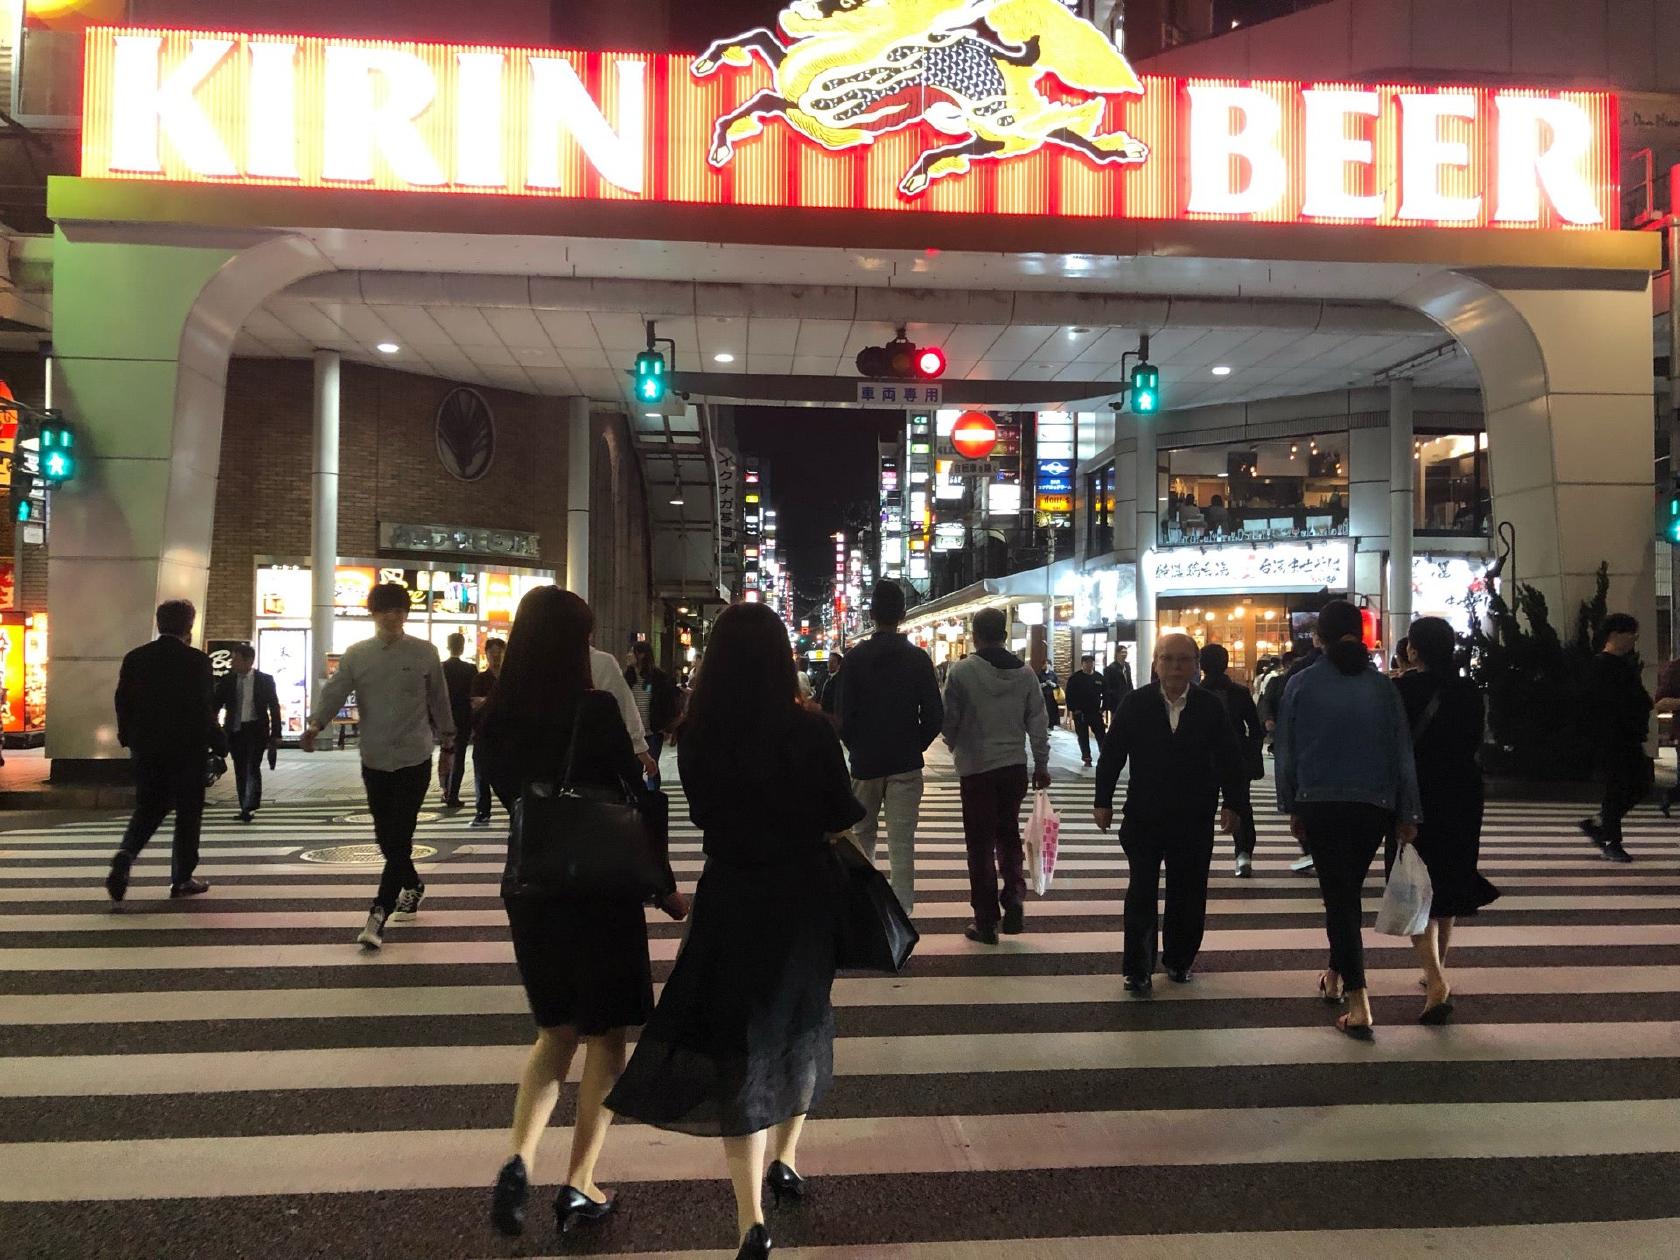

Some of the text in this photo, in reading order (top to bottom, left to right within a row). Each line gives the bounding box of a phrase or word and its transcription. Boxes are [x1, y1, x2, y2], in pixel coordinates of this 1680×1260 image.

[109, 36, 1603, 224] KIRIN BEER
[861, 386, 939, 402] 車両専用
